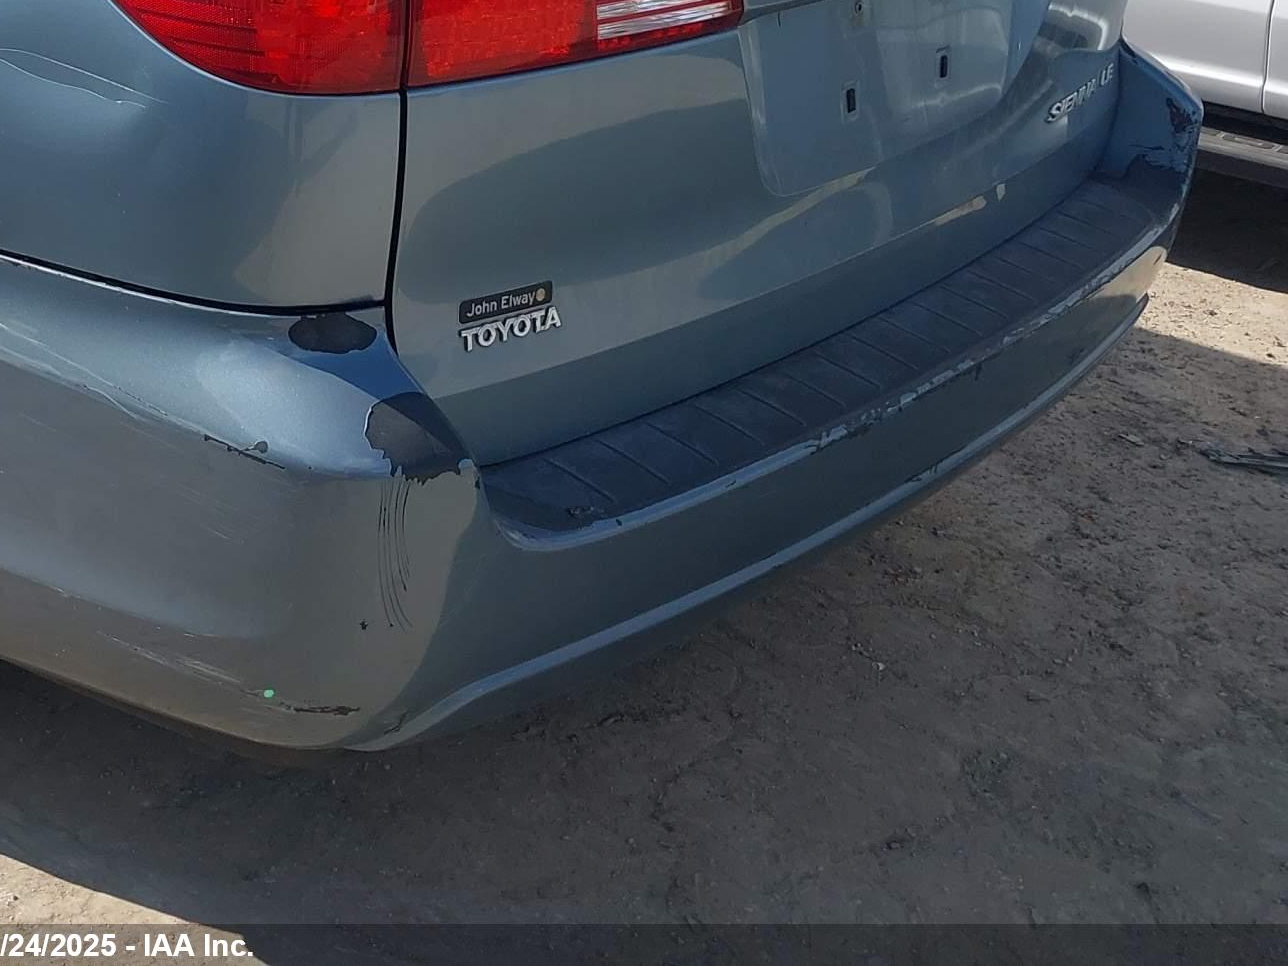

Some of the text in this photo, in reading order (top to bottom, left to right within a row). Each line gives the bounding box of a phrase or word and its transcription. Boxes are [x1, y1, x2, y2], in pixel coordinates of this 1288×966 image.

[1045, 62, 1114, 122] SIENNA LE
[466, 291, 536, 317] John Elway
[460, 306, 562, 352] TOYOTA
